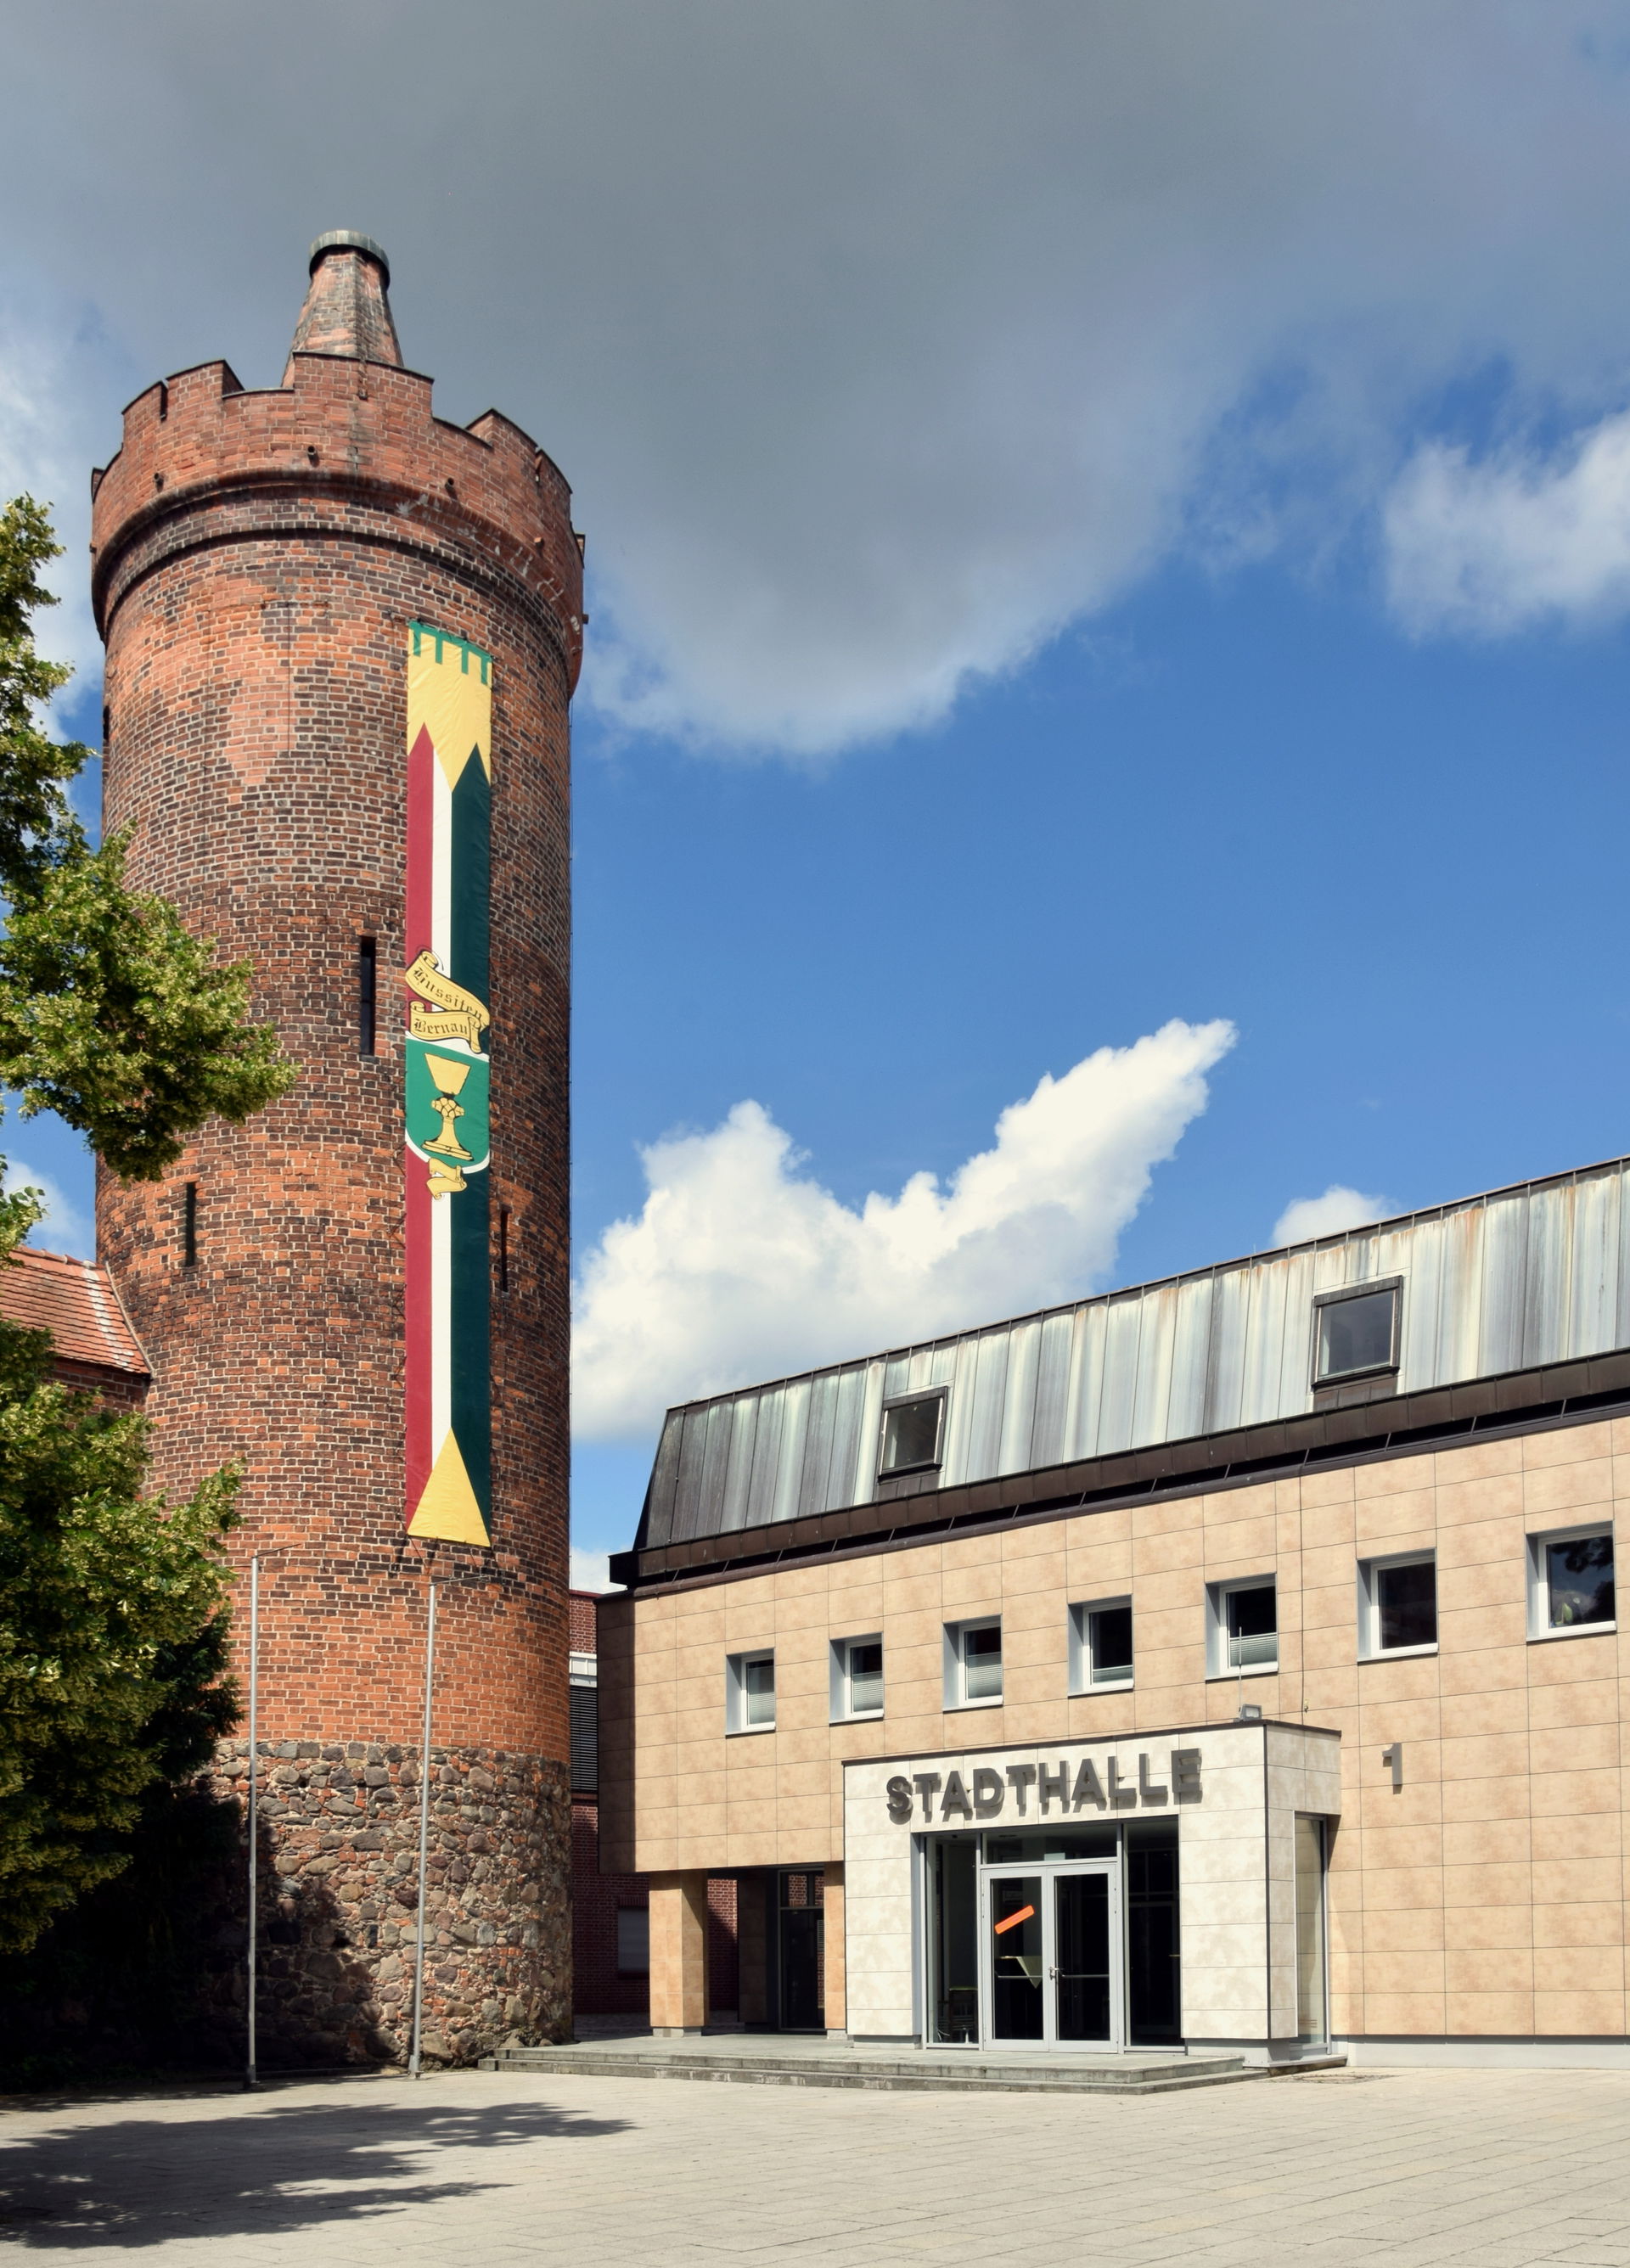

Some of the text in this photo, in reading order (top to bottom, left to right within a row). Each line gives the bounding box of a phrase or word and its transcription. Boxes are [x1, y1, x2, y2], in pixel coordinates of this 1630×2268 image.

[414, 1019, 468, 1035] Bernau
[886, 1748, 1201, 1814] STADTHALLE
[1382, 1743, 1402, 1786] 1
